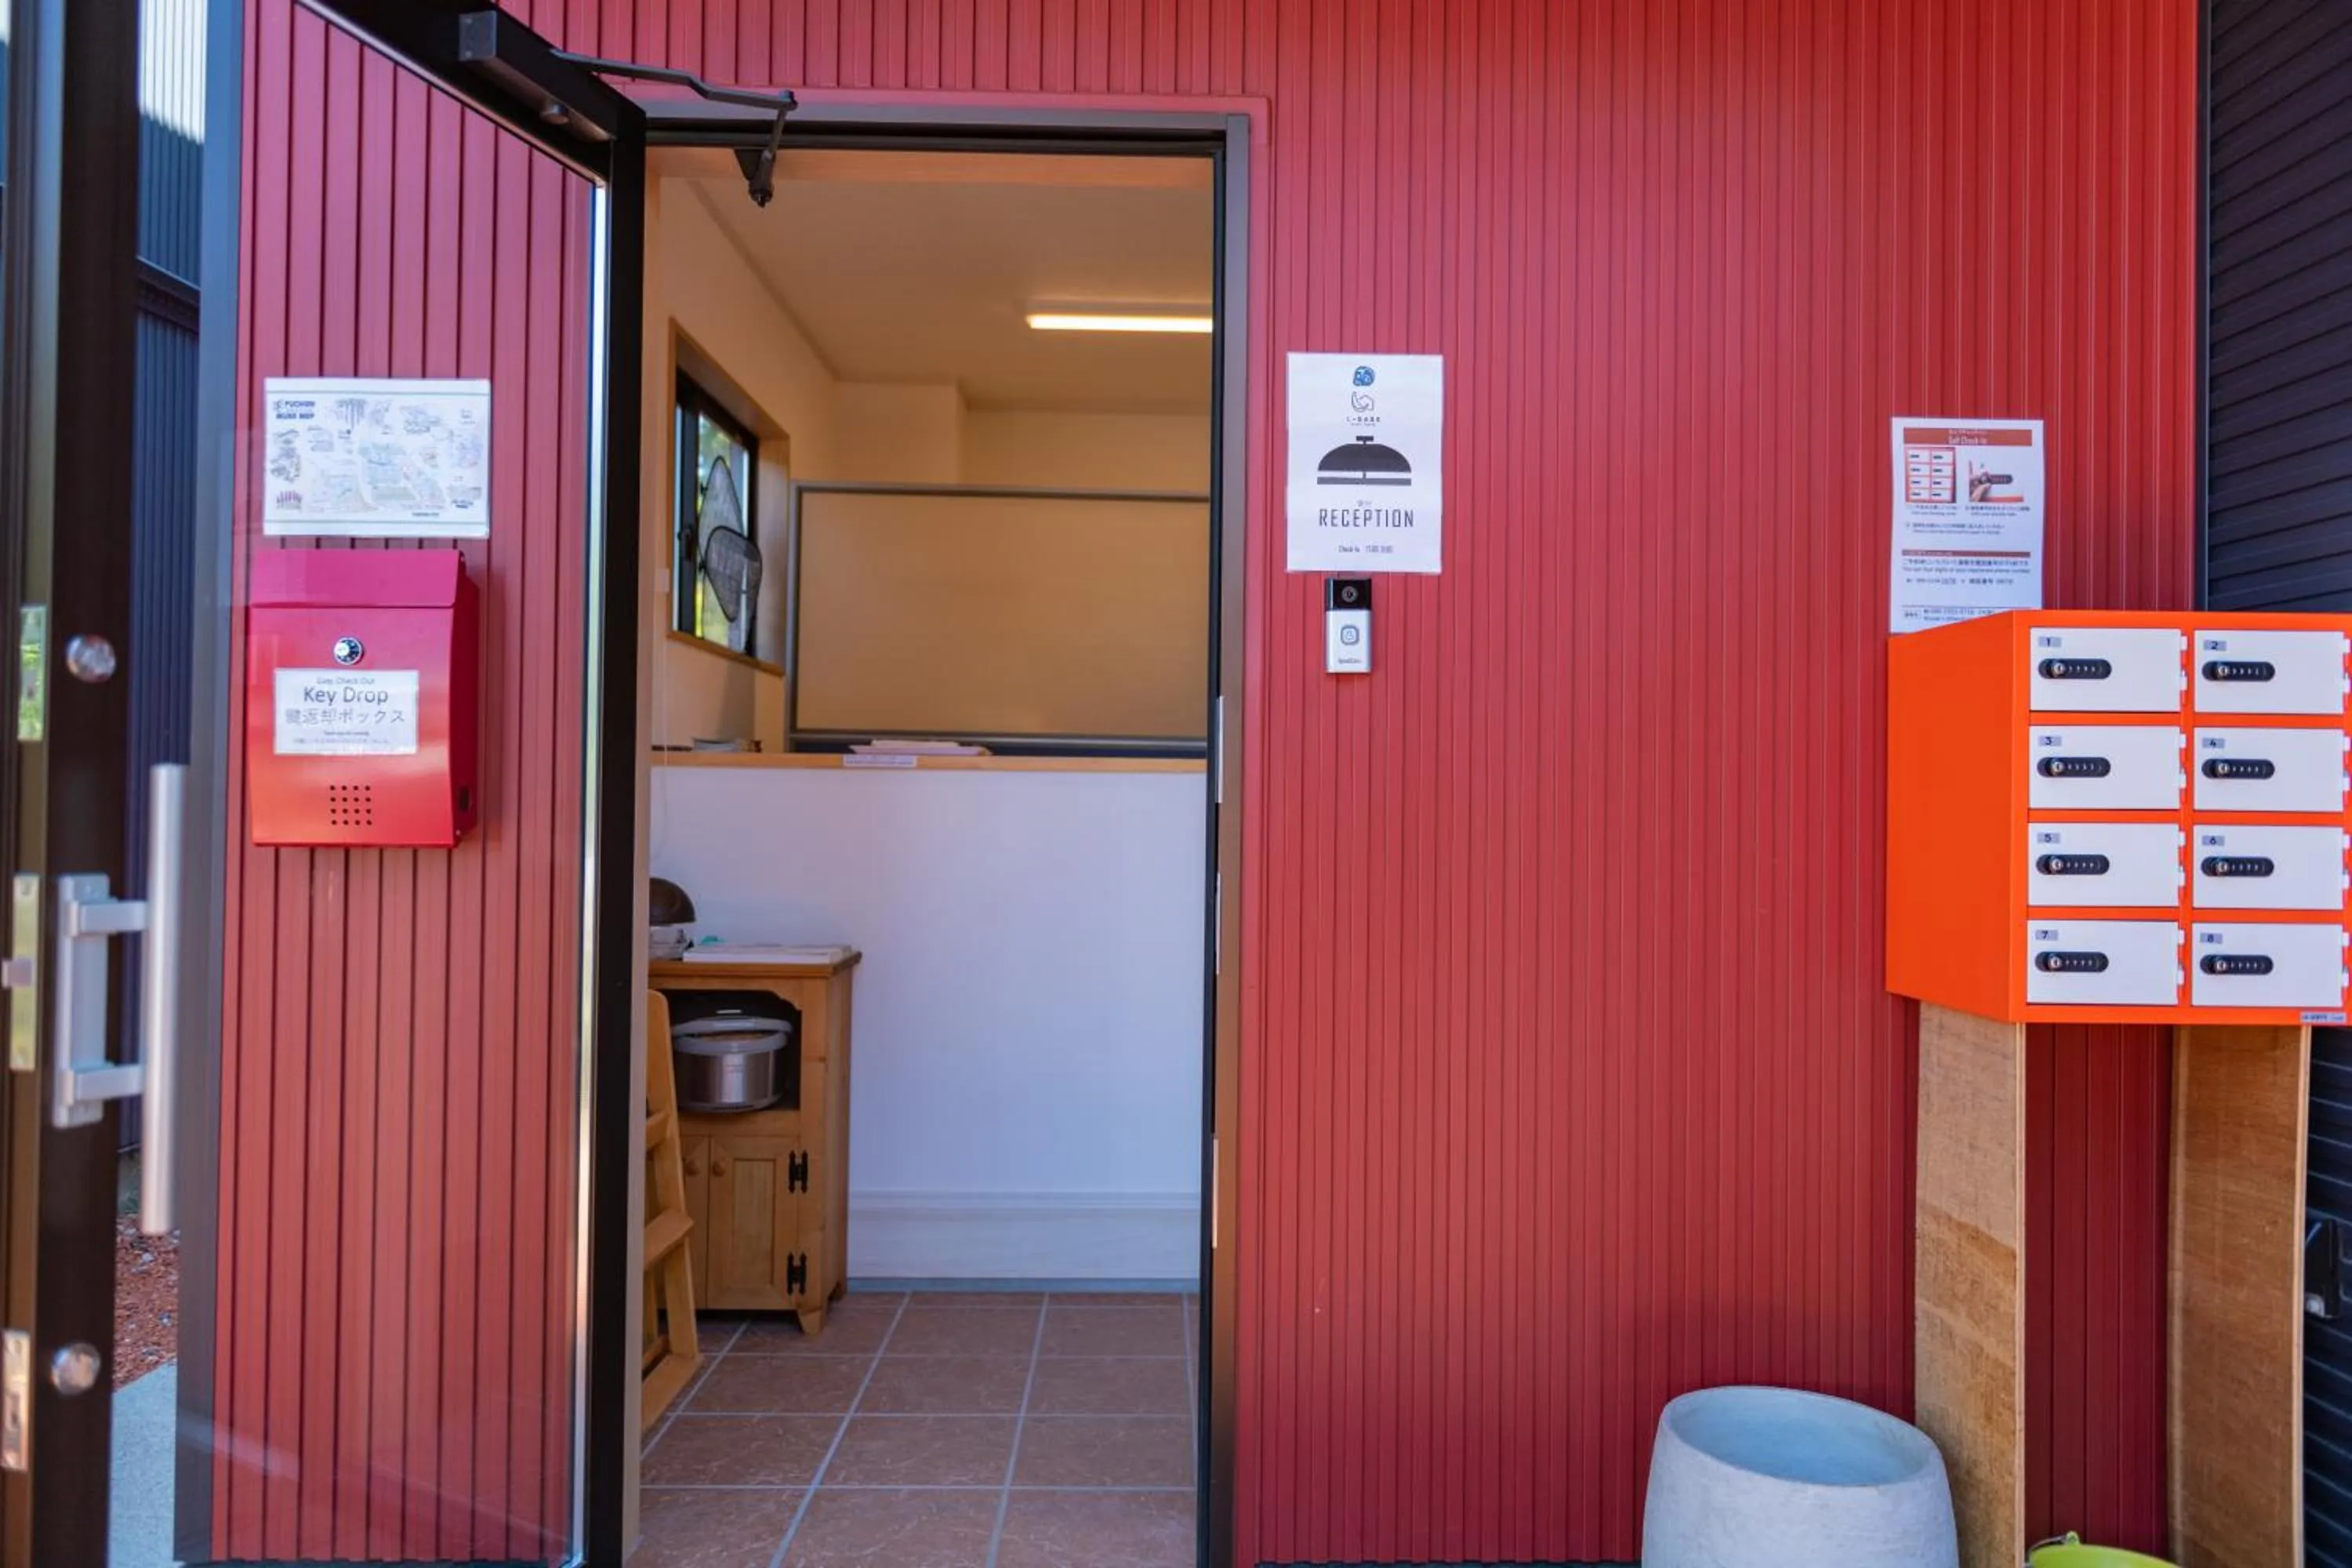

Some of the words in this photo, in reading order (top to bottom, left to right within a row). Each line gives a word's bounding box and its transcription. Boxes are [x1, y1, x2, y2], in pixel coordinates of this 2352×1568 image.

[1319, 509, 1414, 528] RECEPTION
[303, 686, 337, 706] Key
[343, 686, 389, 706] Drop
[2045, 736, 2053, 746] 3
[2044, 833, 2052, 843] 5
[2041, 930, 2049, 939] 7
